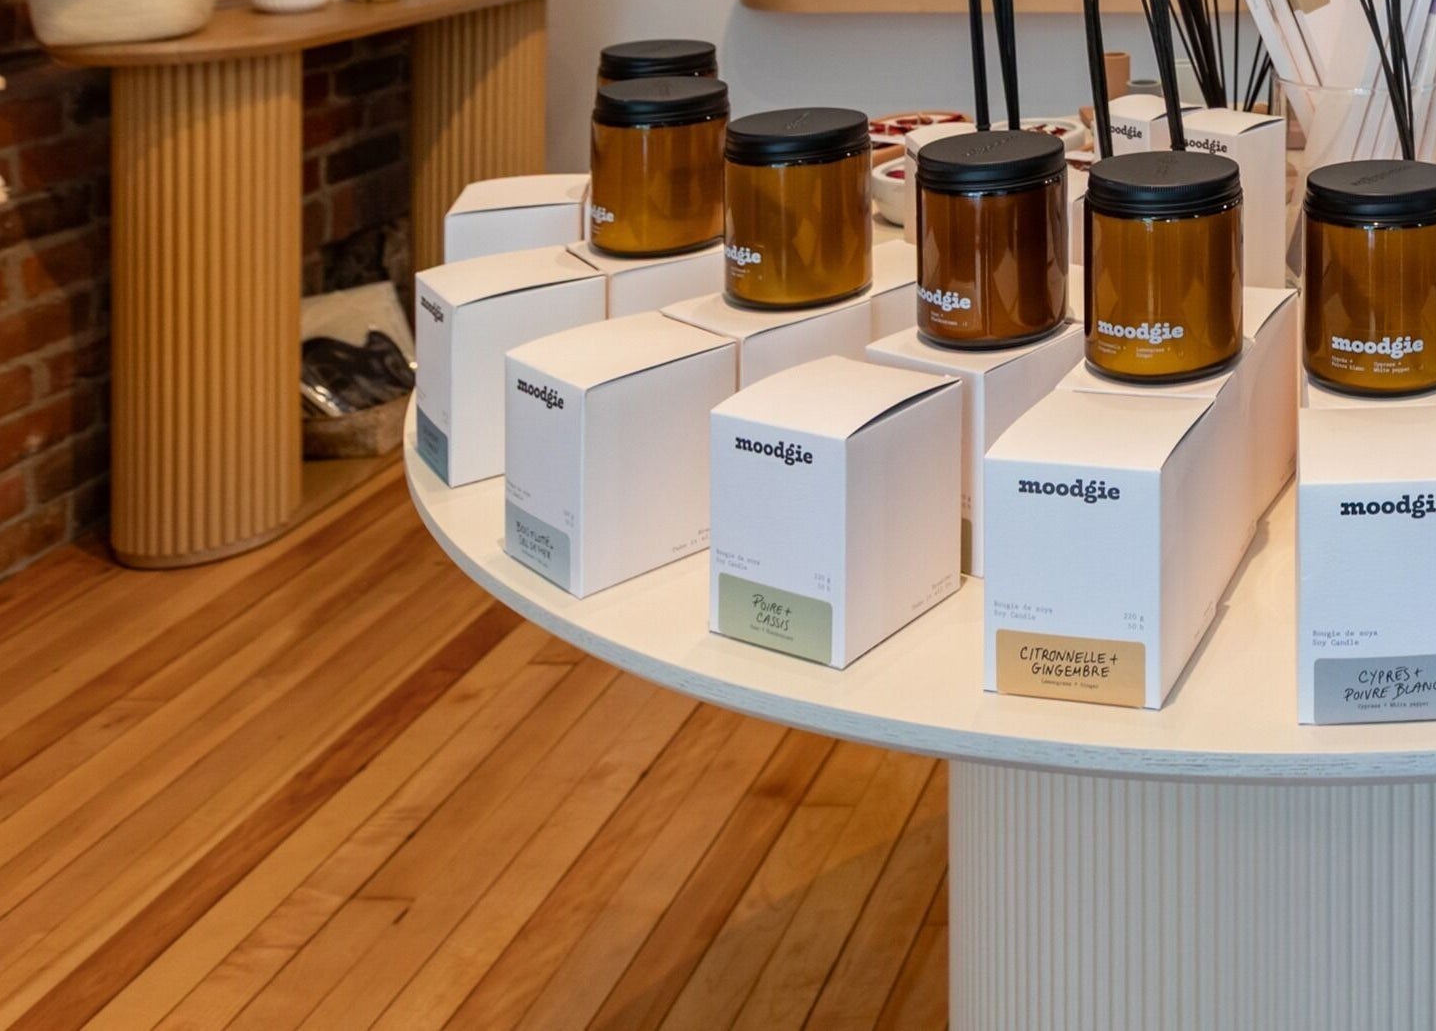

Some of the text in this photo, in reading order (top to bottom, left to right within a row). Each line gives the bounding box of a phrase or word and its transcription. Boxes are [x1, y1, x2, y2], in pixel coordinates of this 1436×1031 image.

[1110, 125, 1142, 139] oodgie
[1098, 320, 1184, 345] moodgie
[1331, 336, 1424, 359] moodgie
[517, 378, 564, 410] moodgie
[735, 436, 813, 466] moodgie
[1018, 479, 1121, 504] moodgie
[1020, 646, 1106, 664] CITRONNELLE
[1031, 662, 1110, 678] GINGEMBRE
[1344, 685, 1391, 702] POIVRE
